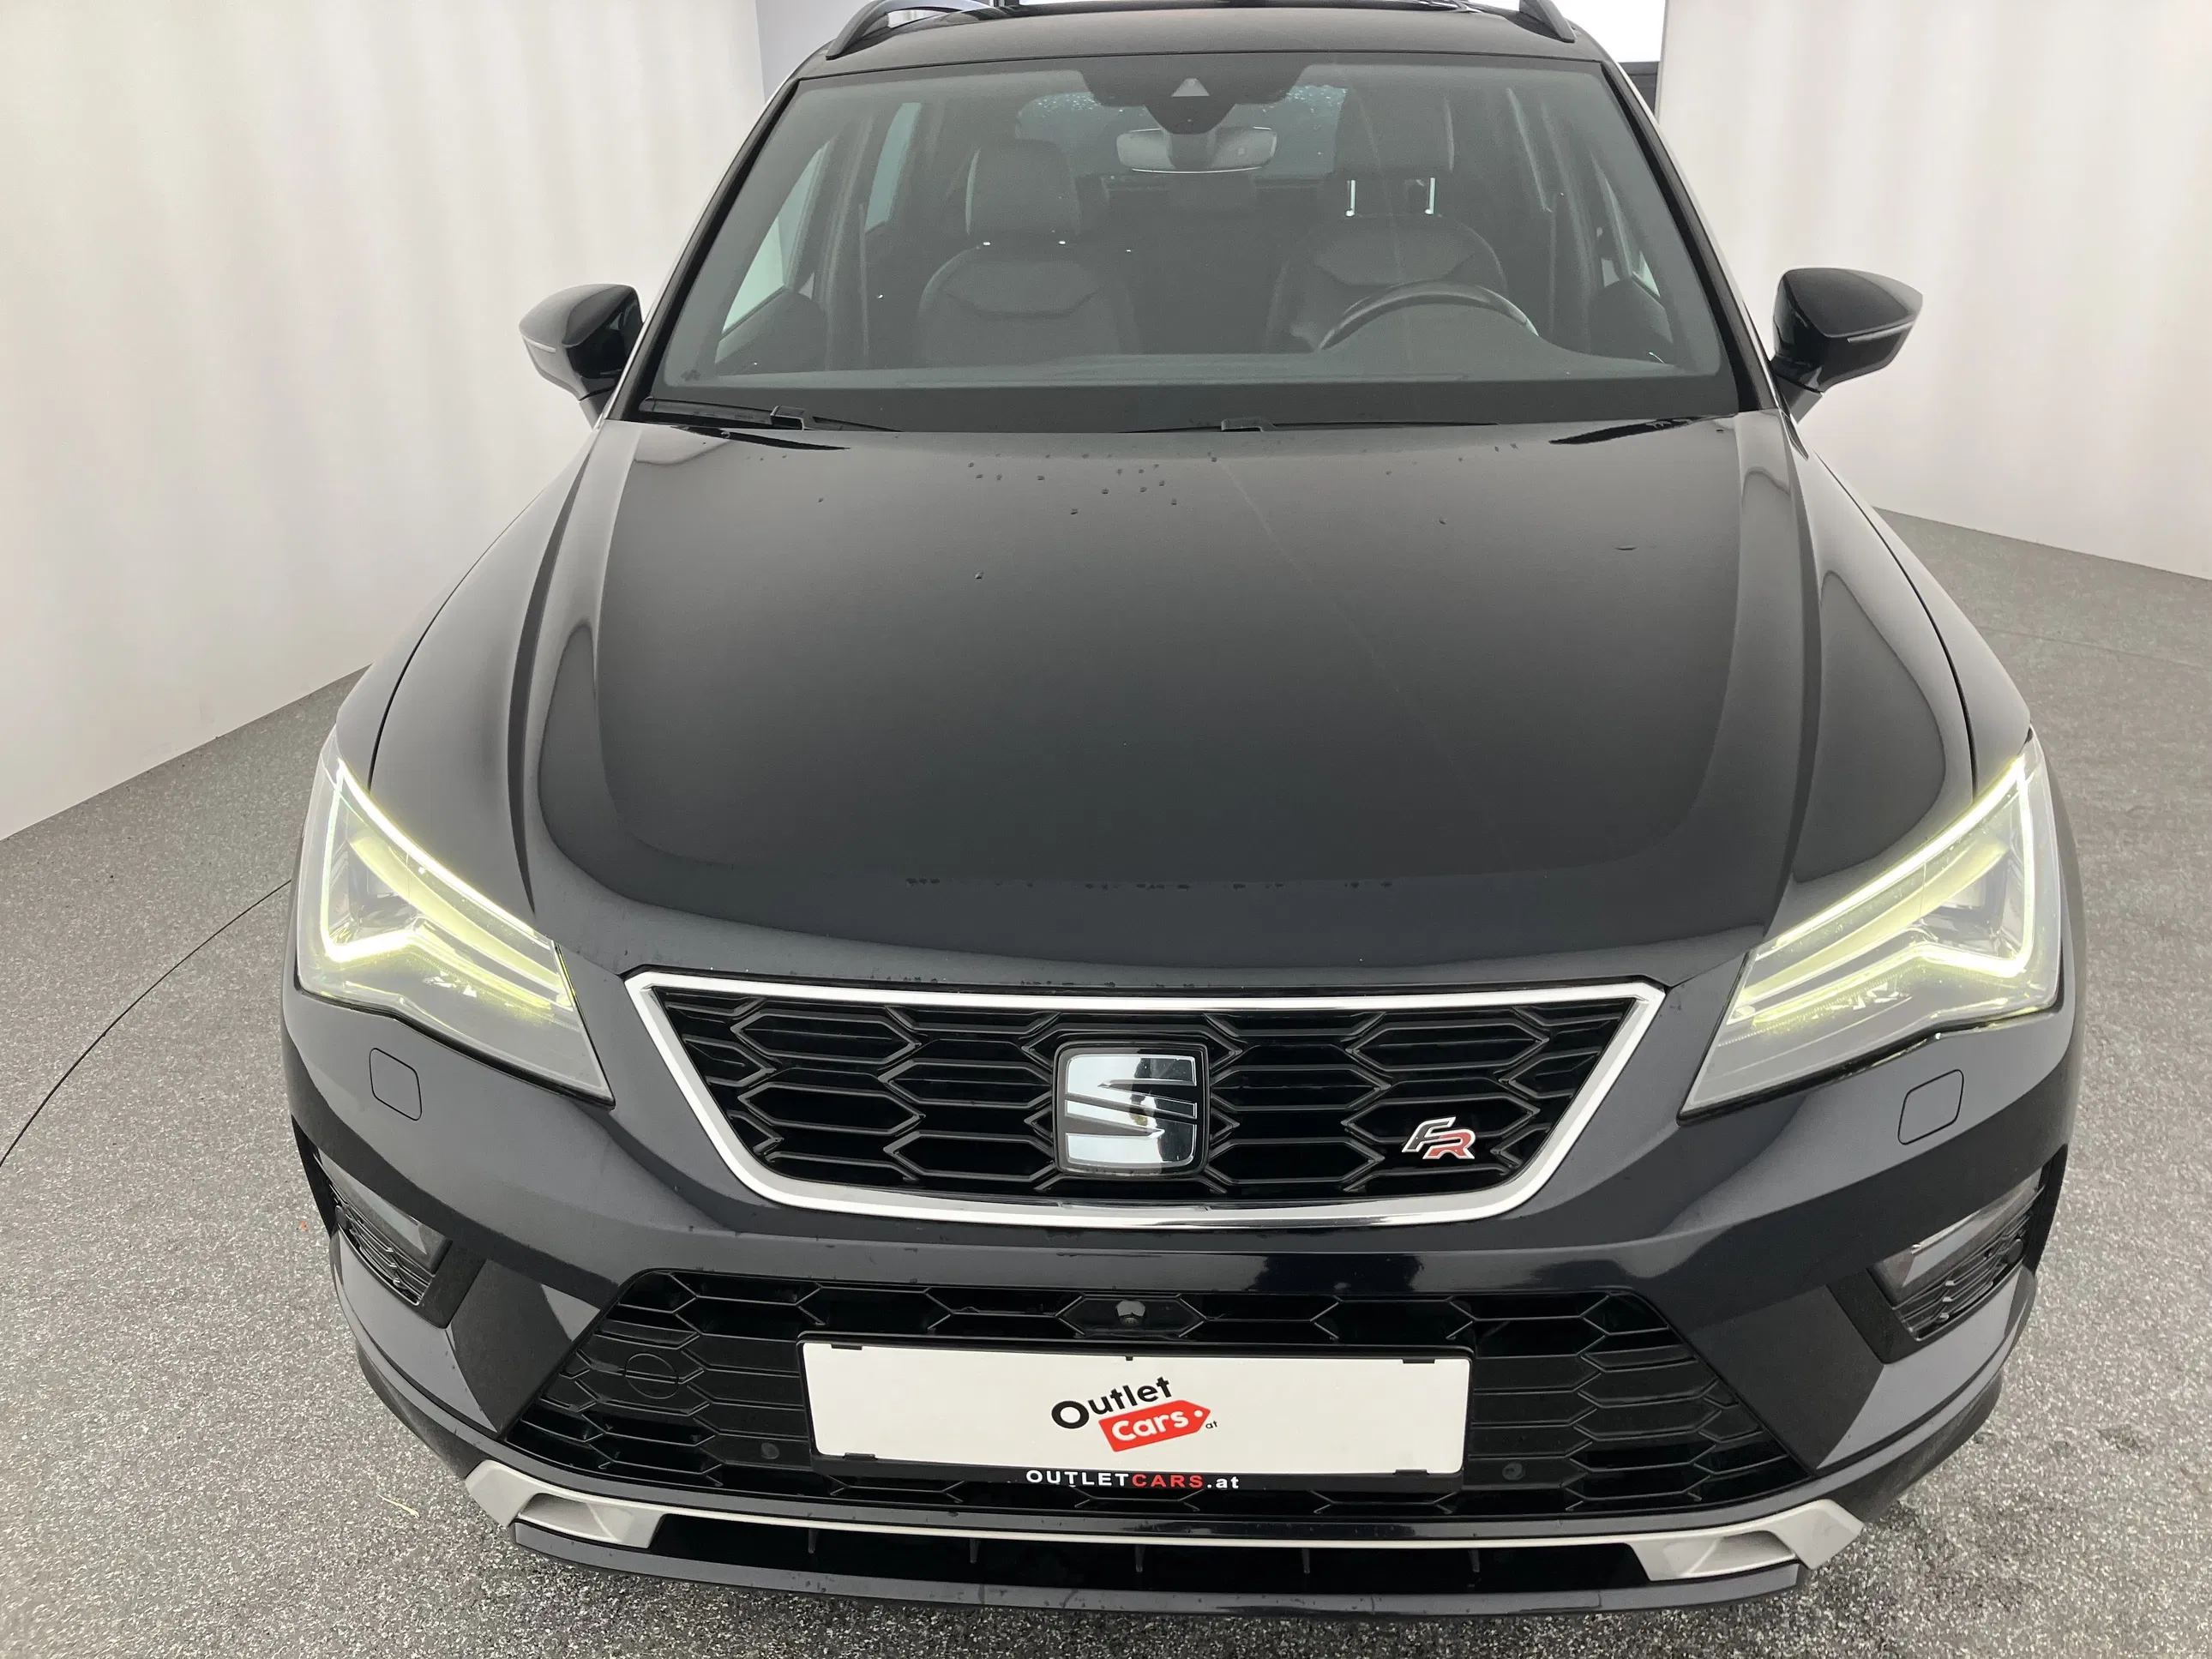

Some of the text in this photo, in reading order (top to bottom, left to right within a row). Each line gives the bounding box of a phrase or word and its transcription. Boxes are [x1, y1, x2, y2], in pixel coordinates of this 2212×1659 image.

[1401, 1116, 1476, 1159] FR
[1051, 1376, 1172, 1429] Outlet
[1025, 1470, 1240, 1489] OUTLETCARS.at
